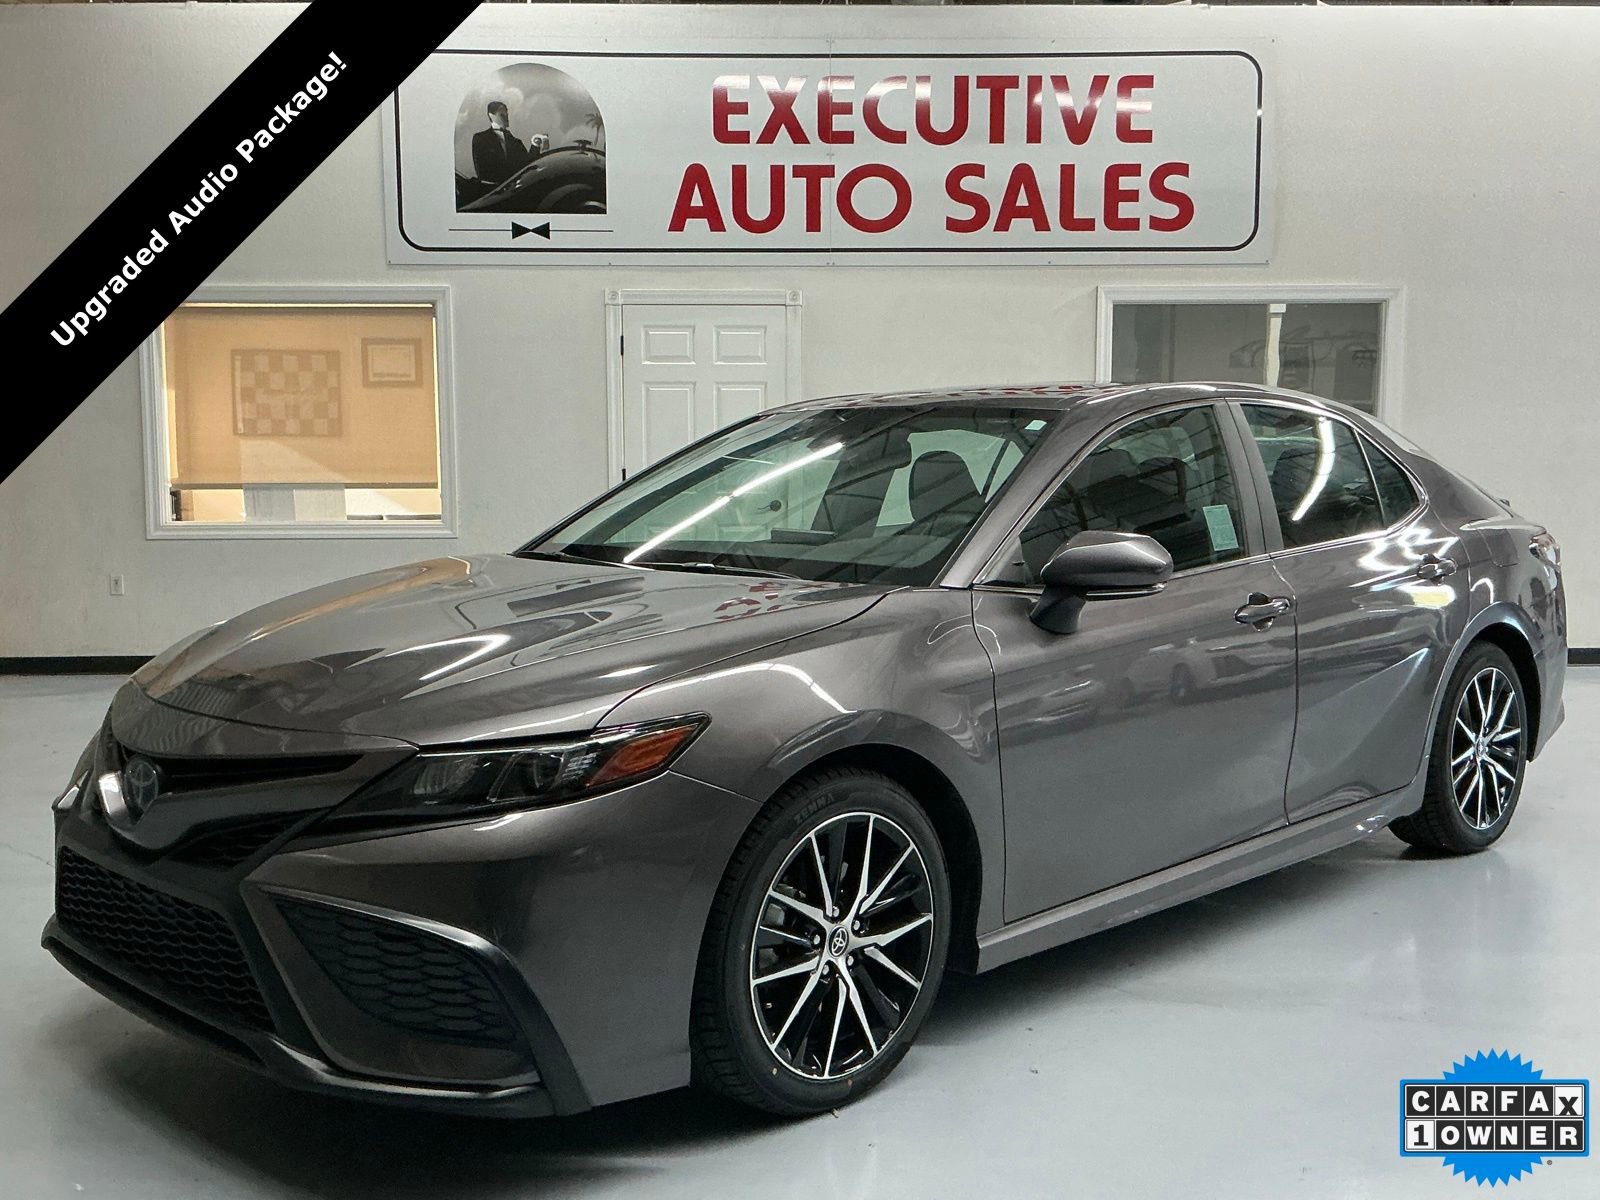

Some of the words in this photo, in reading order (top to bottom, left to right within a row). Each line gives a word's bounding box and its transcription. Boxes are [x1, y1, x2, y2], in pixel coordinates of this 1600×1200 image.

[712, 74, 1155, 146] EXECUTIVE
[667, 162, 913, 234] AUTO
[944, 162, 1195, 233] SALES
